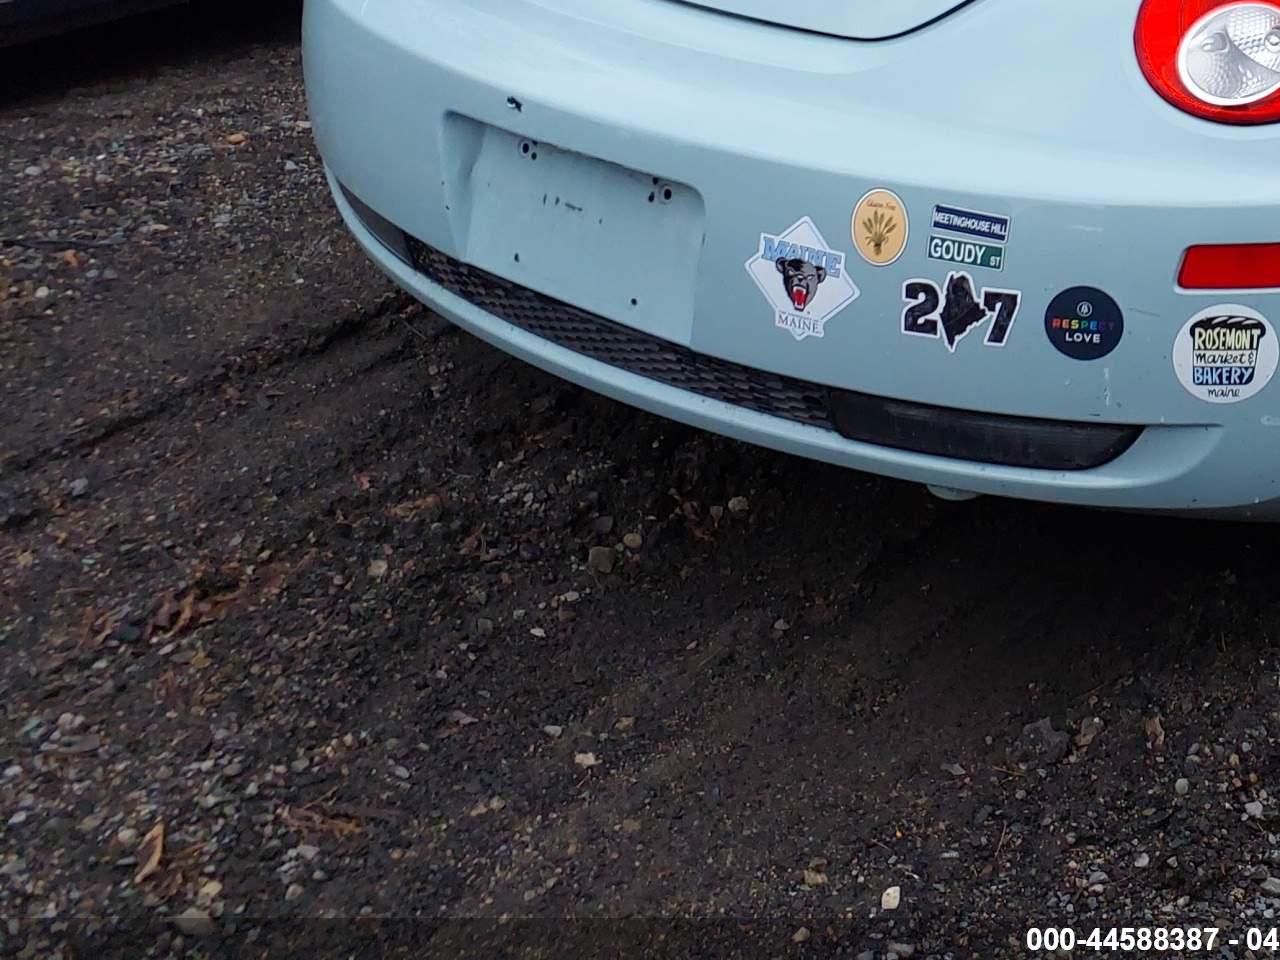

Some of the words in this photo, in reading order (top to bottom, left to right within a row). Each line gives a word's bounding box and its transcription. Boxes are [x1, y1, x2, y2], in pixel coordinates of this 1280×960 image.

[934, 211, 990, 233] MEETINGHOUSE
[990, 222, 1006, 235] HILL
[762, 237, 842, 279] MAINE
[930, 239, 986, 264] GOUDY
[989, 255, 1001, 267] ST
[778, 311, 823, 335] MAINE
[1065, 332, 1101, 343] LOVE
[1194, 327, 1261, 350] ROSEMONT
[1194, 366, 1253, 385] BAKERY
